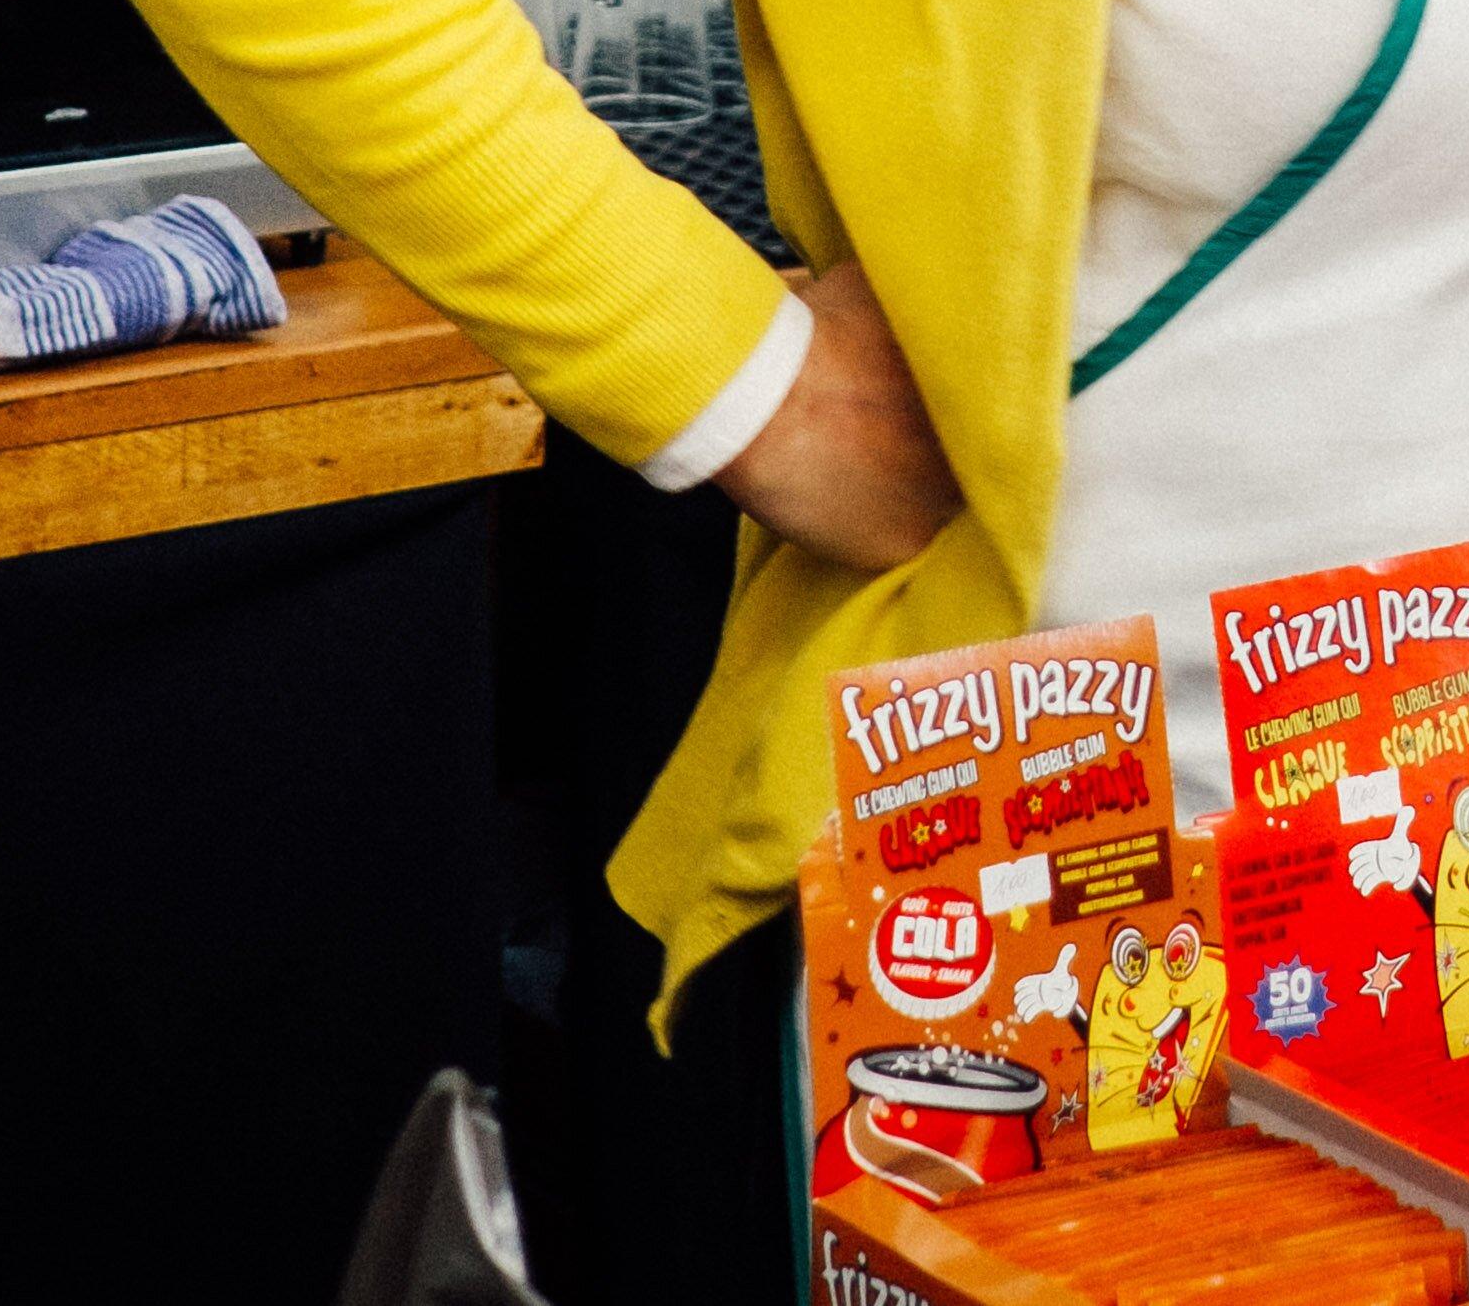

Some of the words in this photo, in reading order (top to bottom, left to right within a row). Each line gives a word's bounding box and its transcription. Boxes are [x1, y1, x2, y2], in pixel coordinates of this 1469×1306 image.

[1225, 596, 1370, 693] frizzy
[840, 669, 1002, 774] frizzy
[1010, 658, 1153, 744] pazzy
[1244, 727, 1260, 753] LE
[1260, 708, 1313, 746] CHEWING
[1313, 699, 1340, 730] GUM
[1340, 691, 1361, 720] QUI
[1391, 680, 1443, 719] BUBBLE
[1020, 744, 1074, 783] BUBBLE
[1074, 731, 1107, 766] GUM
[1254, 739, 1349, 809] CLAQUE
[853, 794, 870, 821] LE
[870, 773, 927, 815] CHEWING
[926, 765, 956, 802] GUM
[956, 758, 978, 792] QUI
[891, 914, 978, 962] COLA
[1269, 967, 1313, 1008] 50
